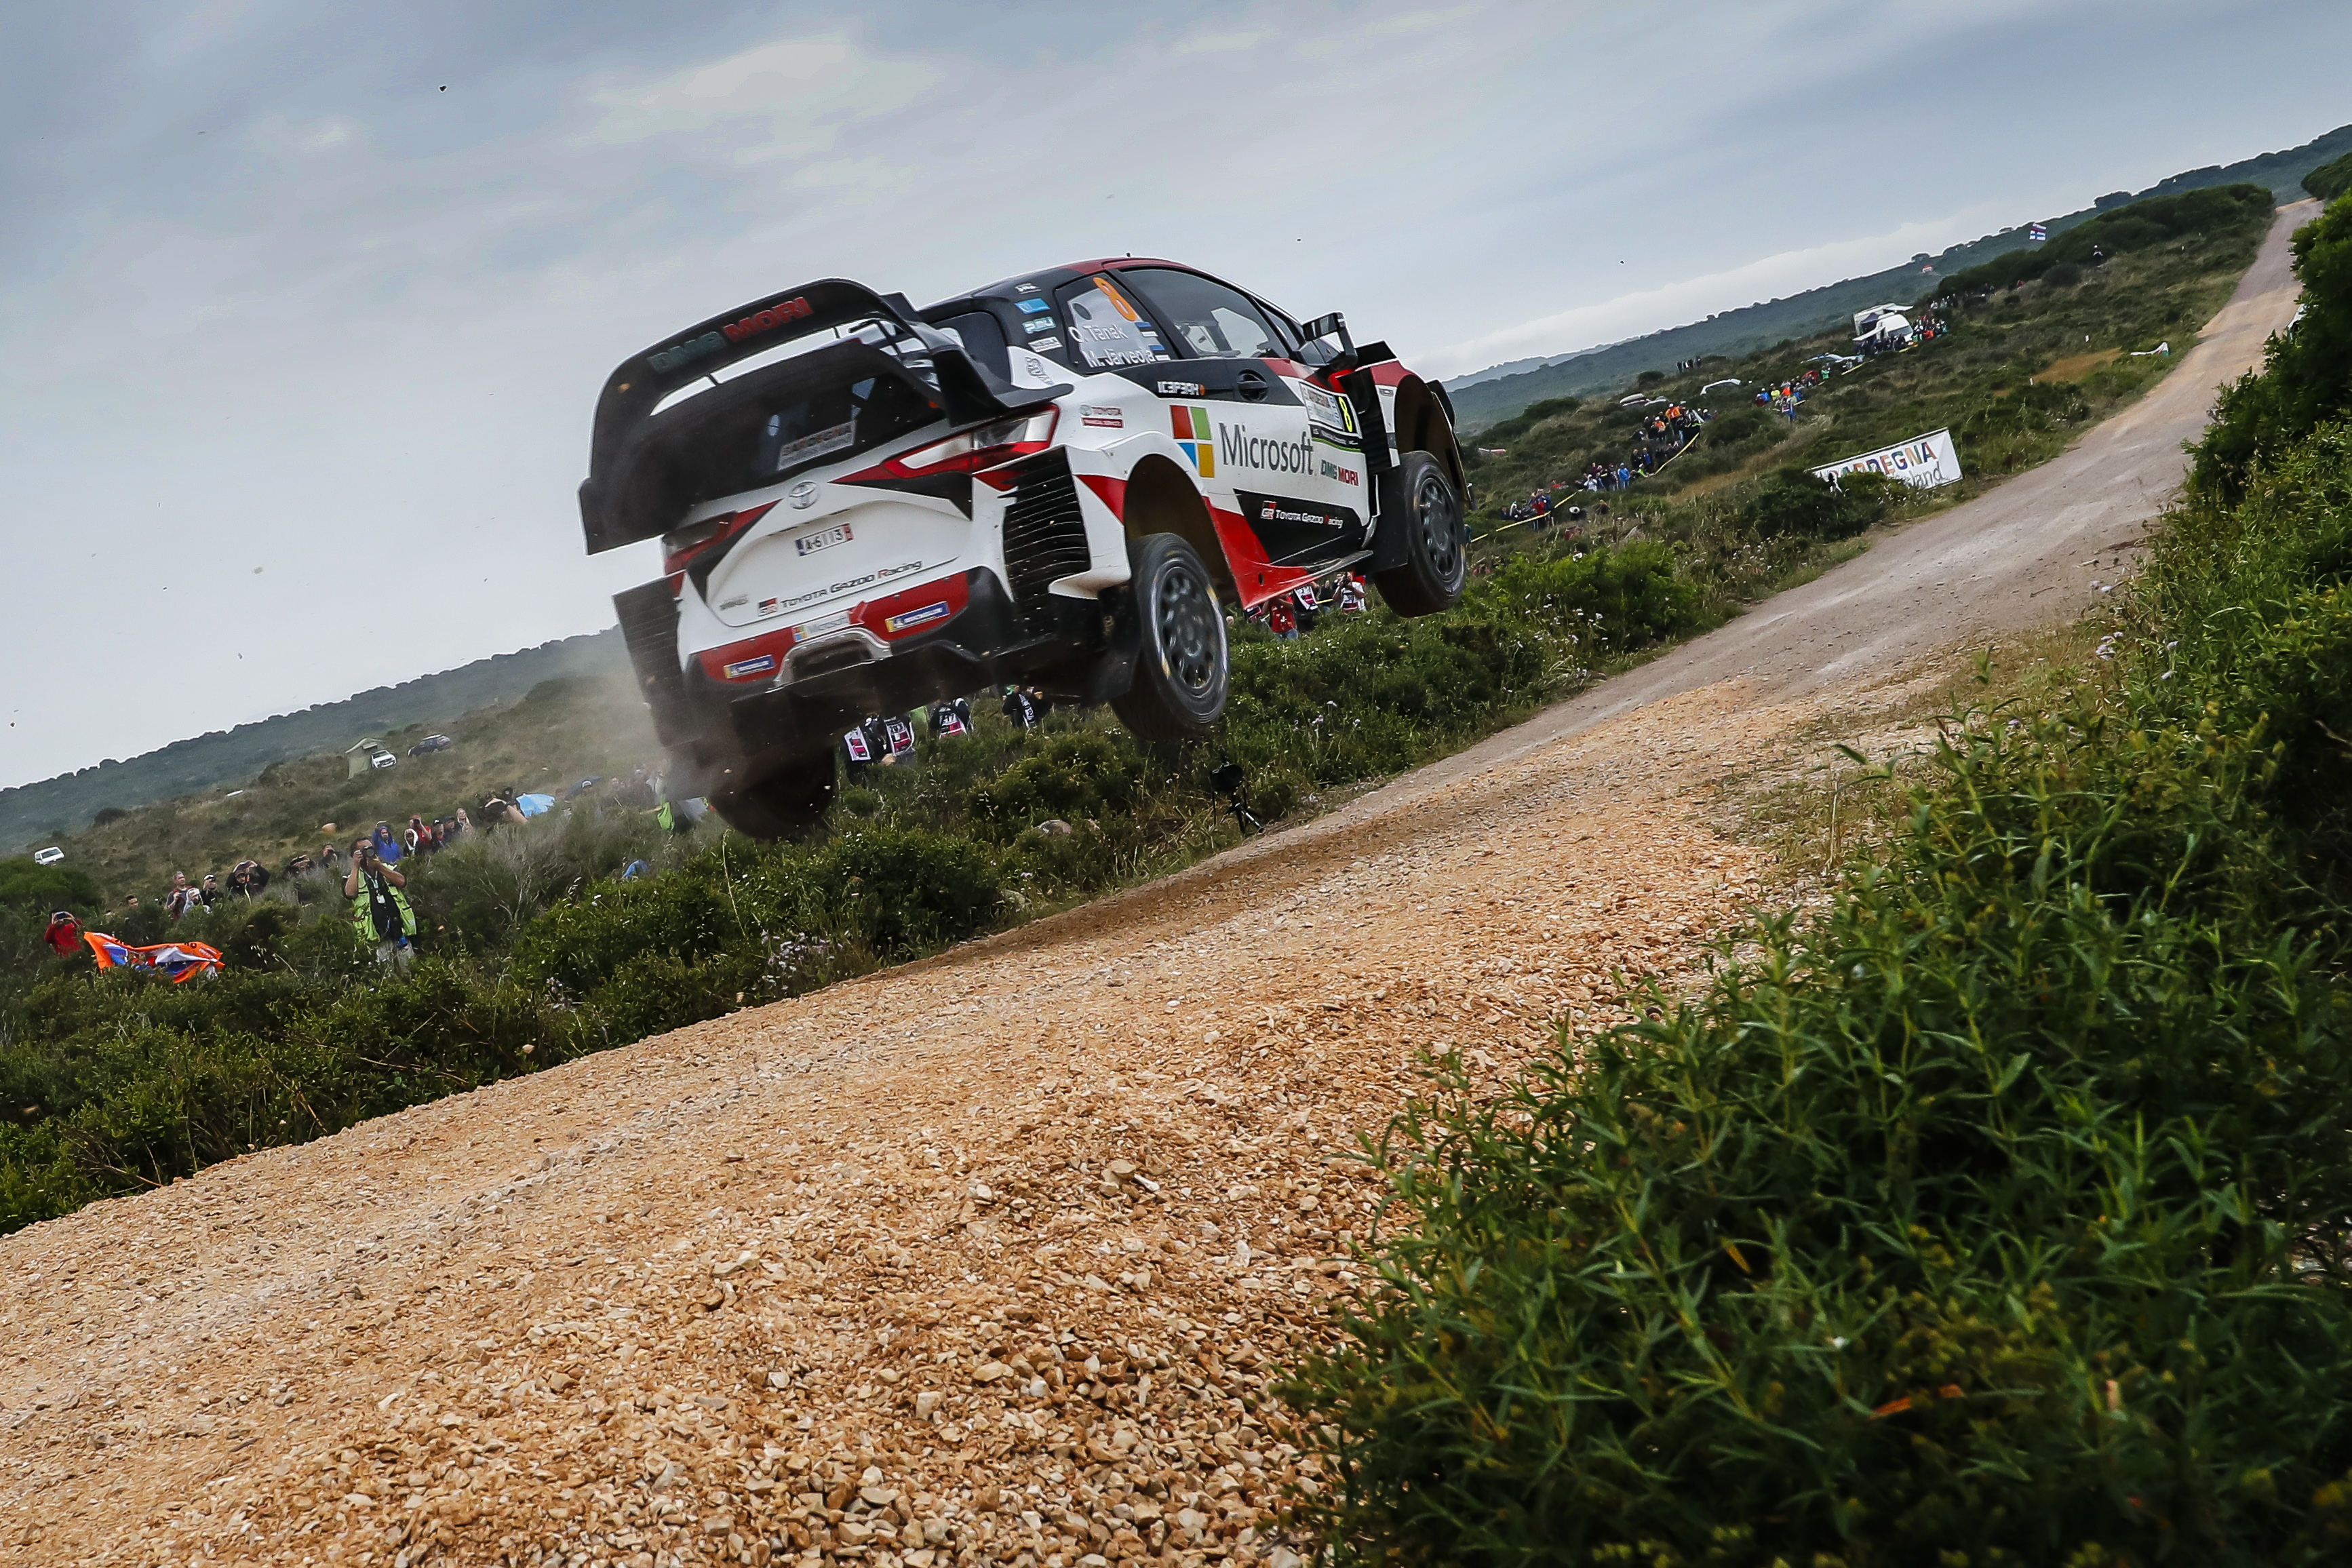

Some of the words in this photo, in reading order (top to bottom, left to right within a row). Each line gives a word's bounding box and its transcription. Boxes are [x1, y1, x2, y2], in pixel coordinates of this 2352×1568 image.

[1093, 277, 1138, 321] 8
[647, 330, 727, 372] DMG
[723, 296, 813, 342] MORI
[1338, 396, 1353, 433] 8
[1219, 423, 1314, 475] Microsoft
[1321, 459, 1337, 480] DMG
[1337, 466, 1360, 486] MORI
[781, 588, 828, 608] TOYOTA
[878, 560, 922, 579] Racing
